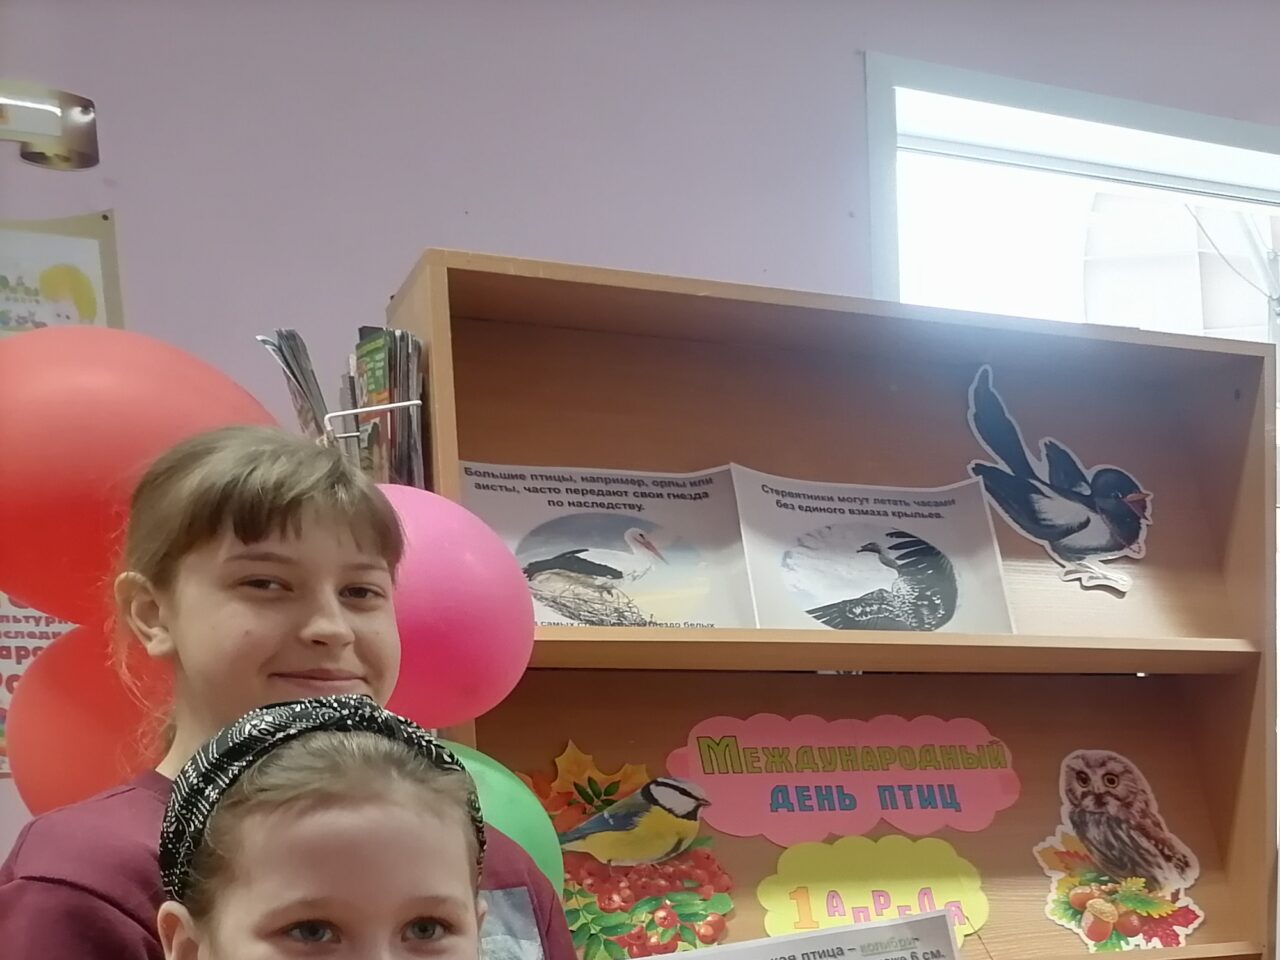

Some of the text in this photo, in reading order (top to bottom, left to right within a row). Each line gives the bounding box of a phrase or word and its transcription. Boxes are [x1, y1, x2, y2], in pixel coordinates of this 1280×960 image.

[464, 467, 527, 482] Большие
[530, 472, 578, 485] птицы,
[474, 481, 710, 502] аисты, часто передают свои гнезда
[837, 496, 870, 506] могут
[547, 498, 646, 513] по наследству.
[775, 499, 945, 520] без единого взмаха крыльев.
[769, 783, 962, 813] ДЕНЬ ПТИЦ
[788, 886, 820, 930] 1
